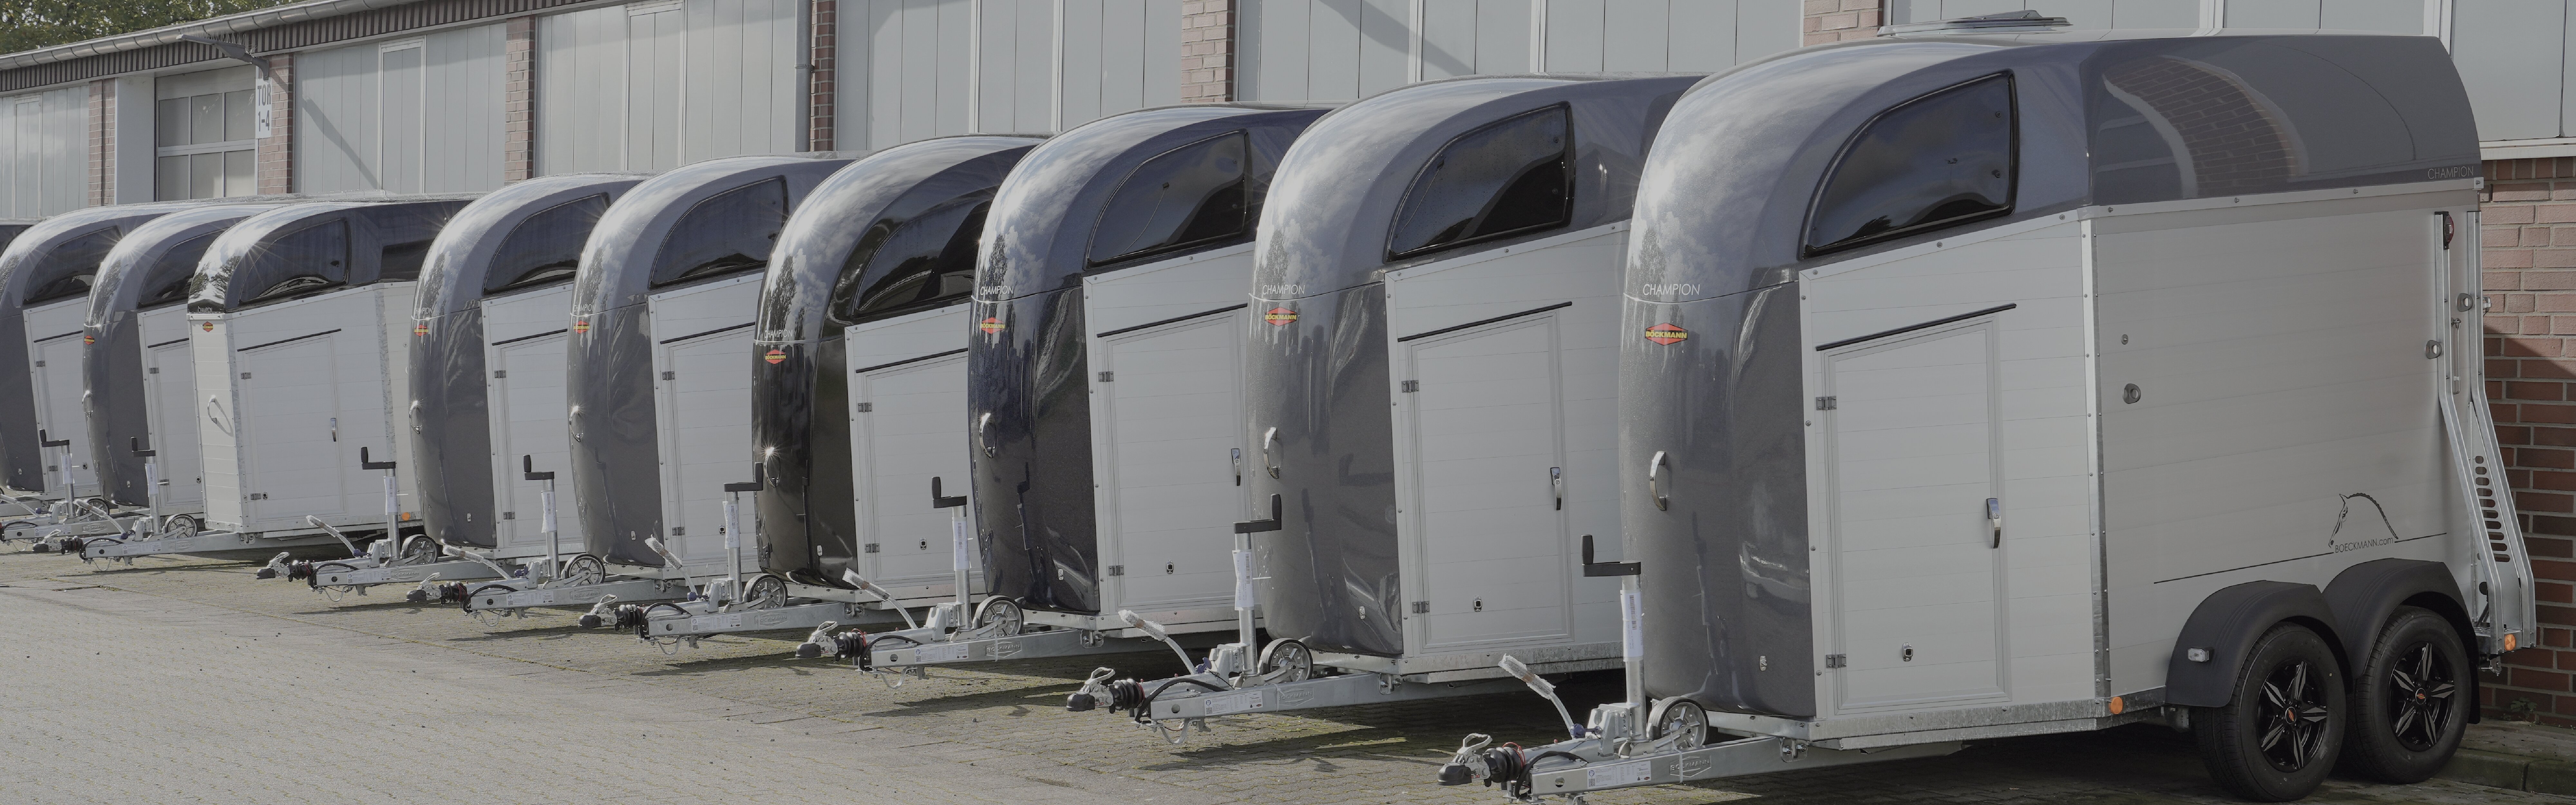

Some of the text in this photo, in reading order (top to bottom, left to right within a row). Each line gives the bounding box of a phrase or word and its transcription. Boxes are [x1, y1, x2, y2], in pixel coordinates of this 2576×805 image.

[258, 84, 271, 106] TOR
[258, 110, 269, 132] 1-4
[2428, 166, 2474, 179] CHAMPION
[980, 285, 1014, 296] CHAMPION
[1262, 284, 1305, 295] CHAMPION
[1643, 283, 1700, 296] CHAMPION
[764, 329, 793, 338] CHAMPION
[1645, 330, 1687, 339] BÖCKMANN
[2335, 537, 2393, 553] BOECKMANN.com
